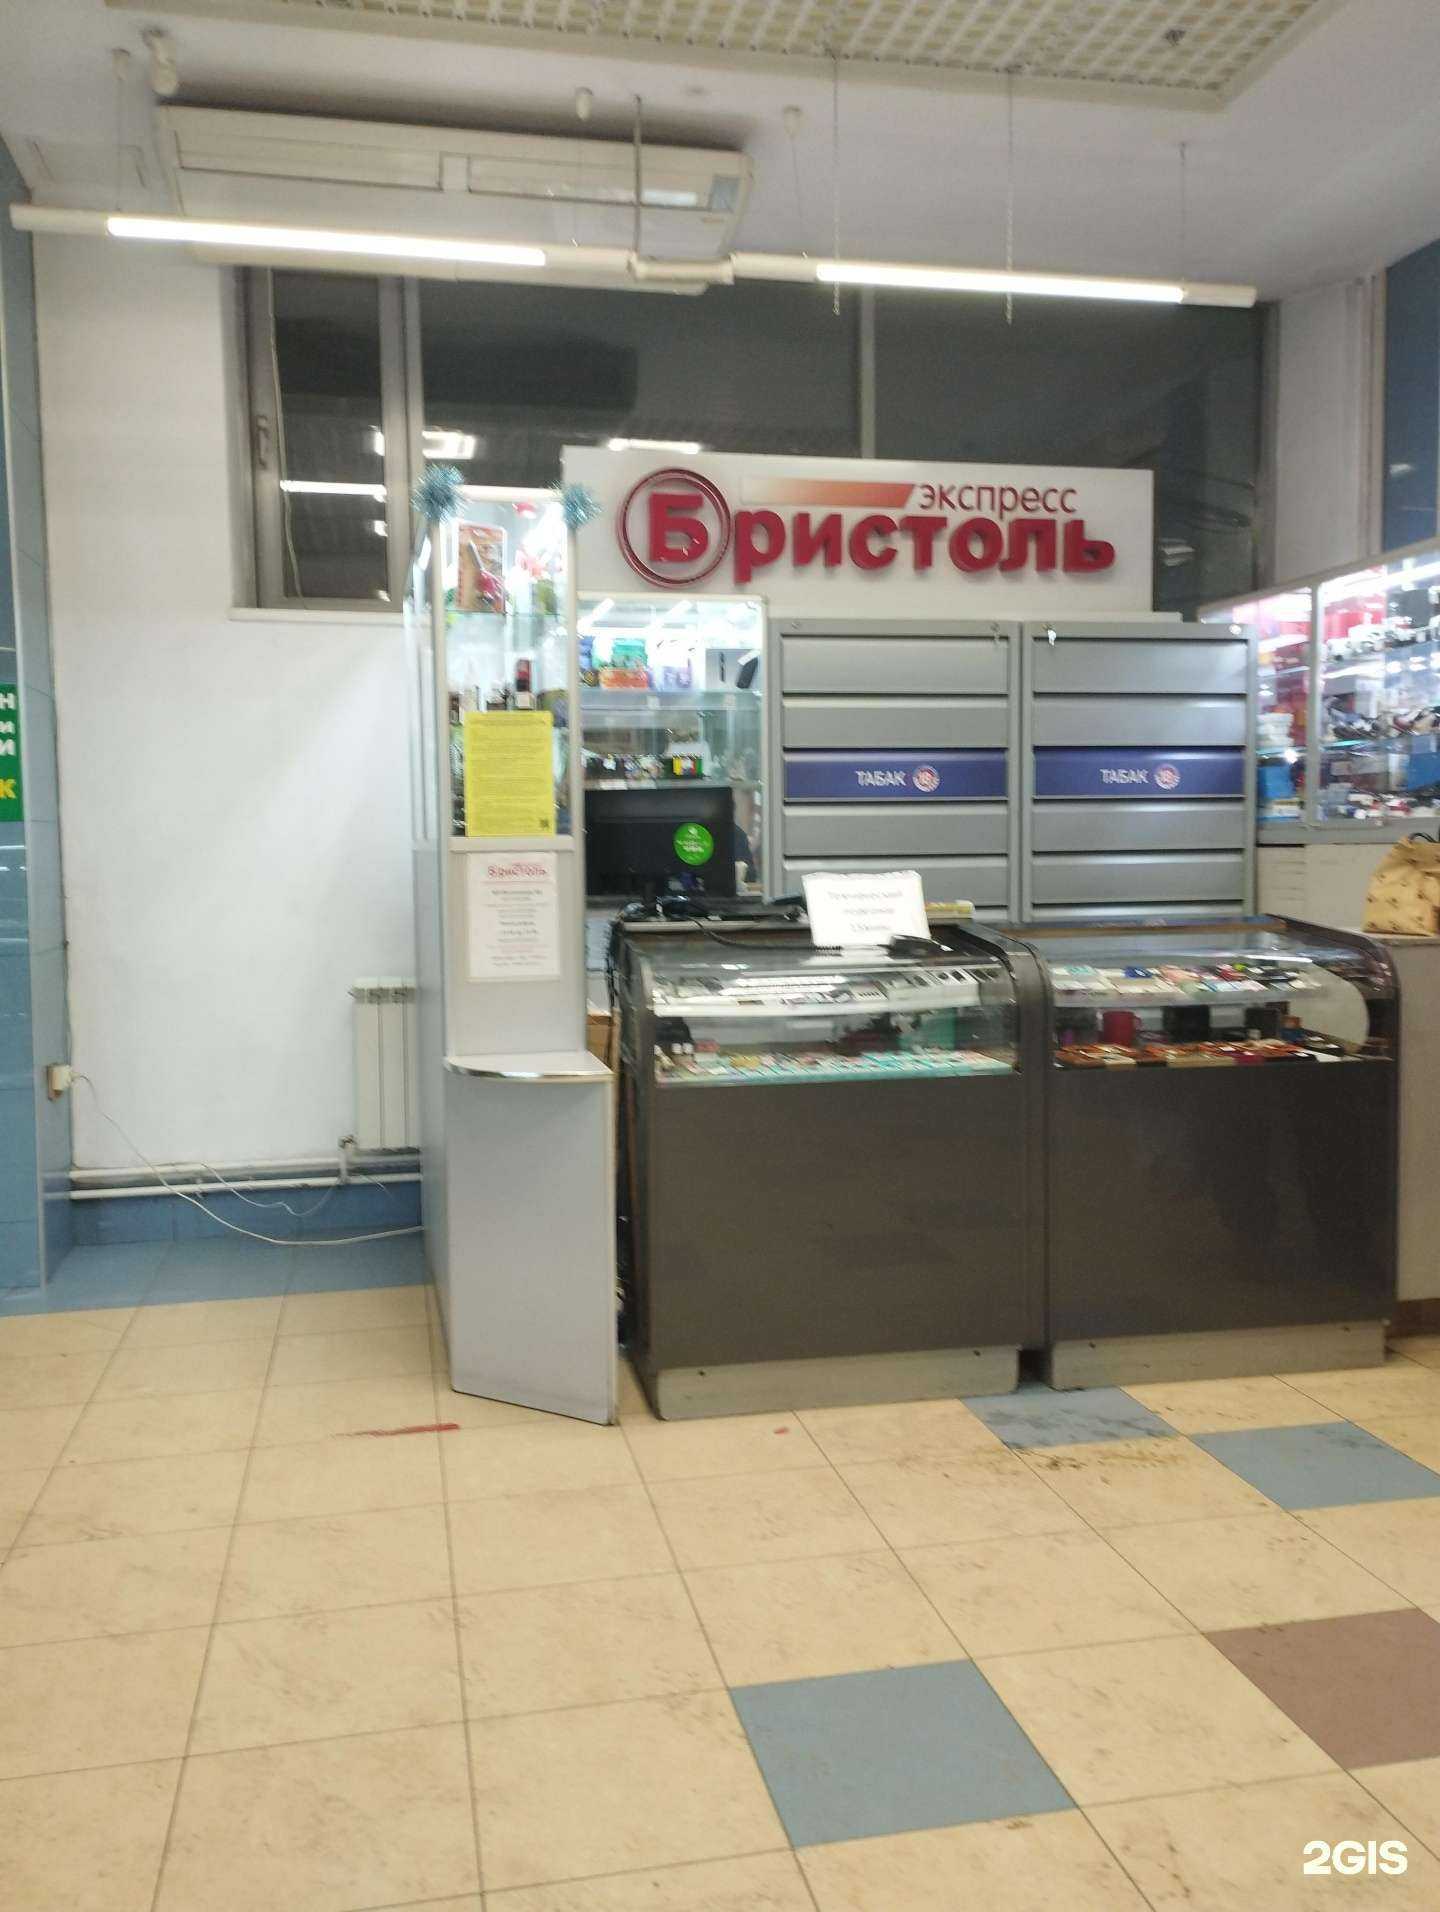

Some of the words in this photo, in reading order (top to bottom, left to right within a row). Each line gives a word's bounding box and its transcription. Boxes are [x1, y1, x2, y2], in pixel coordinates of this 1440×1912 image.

[919, 484, 1078, 520] экспресс
[647, 492, 1116, 584] Бристоль
[855, 770, 907, 787] ТАБАК
[1099, 768, 1150, 784] ТАБАК
